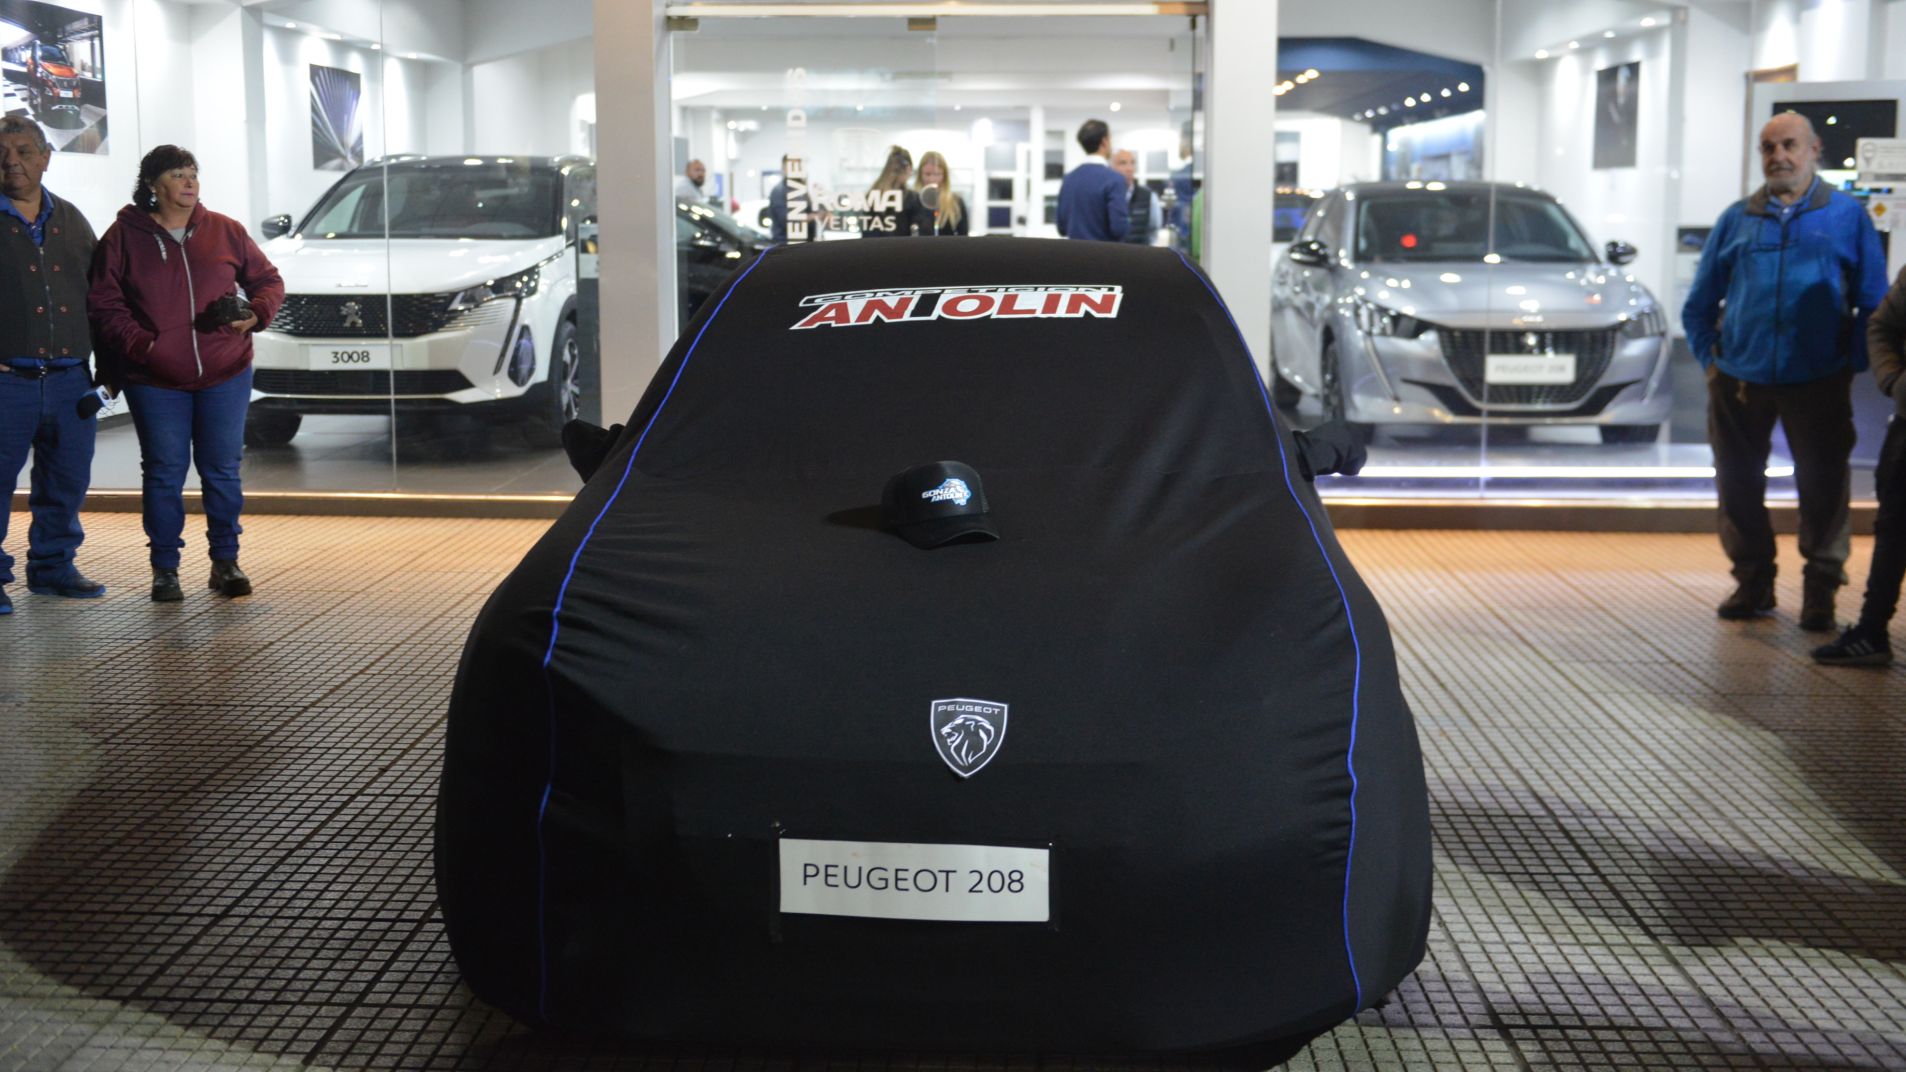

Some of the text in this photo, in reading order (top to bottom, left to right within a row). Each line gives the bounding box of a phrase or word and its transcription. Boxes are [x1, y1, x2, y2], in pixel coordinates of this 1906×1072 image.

[787, 67, 808, 244] ENVEIDS
[812, 190, 903, 212] ROMA
[793, 292, 1120, 329] ANTOLIN
[331, 350, 370, 364] 3008
[938, 704, 1001, 715] PEUGEOT
[803, 862, 1025, 894] PEUGEOT 208
